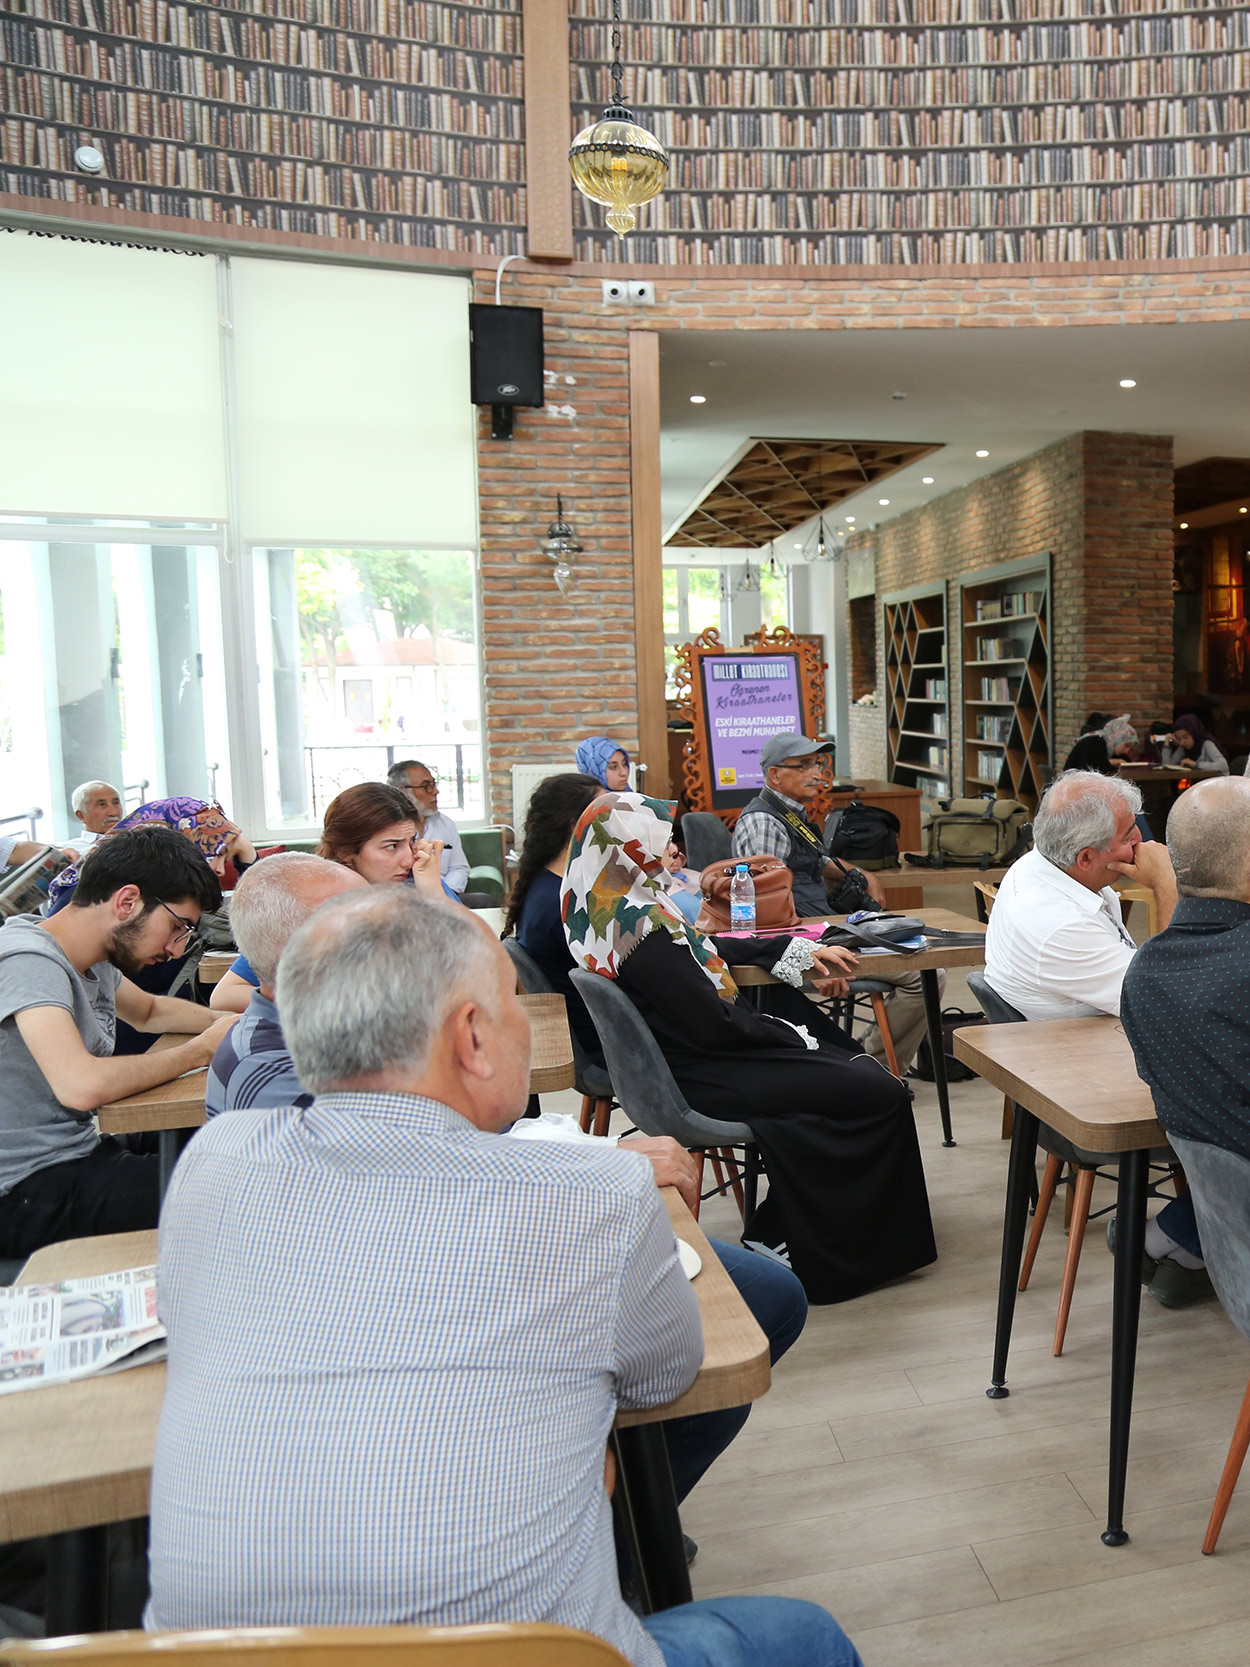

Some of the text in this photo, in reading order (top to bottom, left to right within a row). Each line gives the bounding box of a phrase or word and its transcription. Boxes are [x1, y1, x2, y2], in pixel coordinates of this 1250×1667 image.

[715, 715, 796, 727] ESKİ KIRAATHANELER
[718, 728, 728, 738] VE
[729, 726, 752, 737] BEZMİ
[799, 825, 816, 843] Nikon
